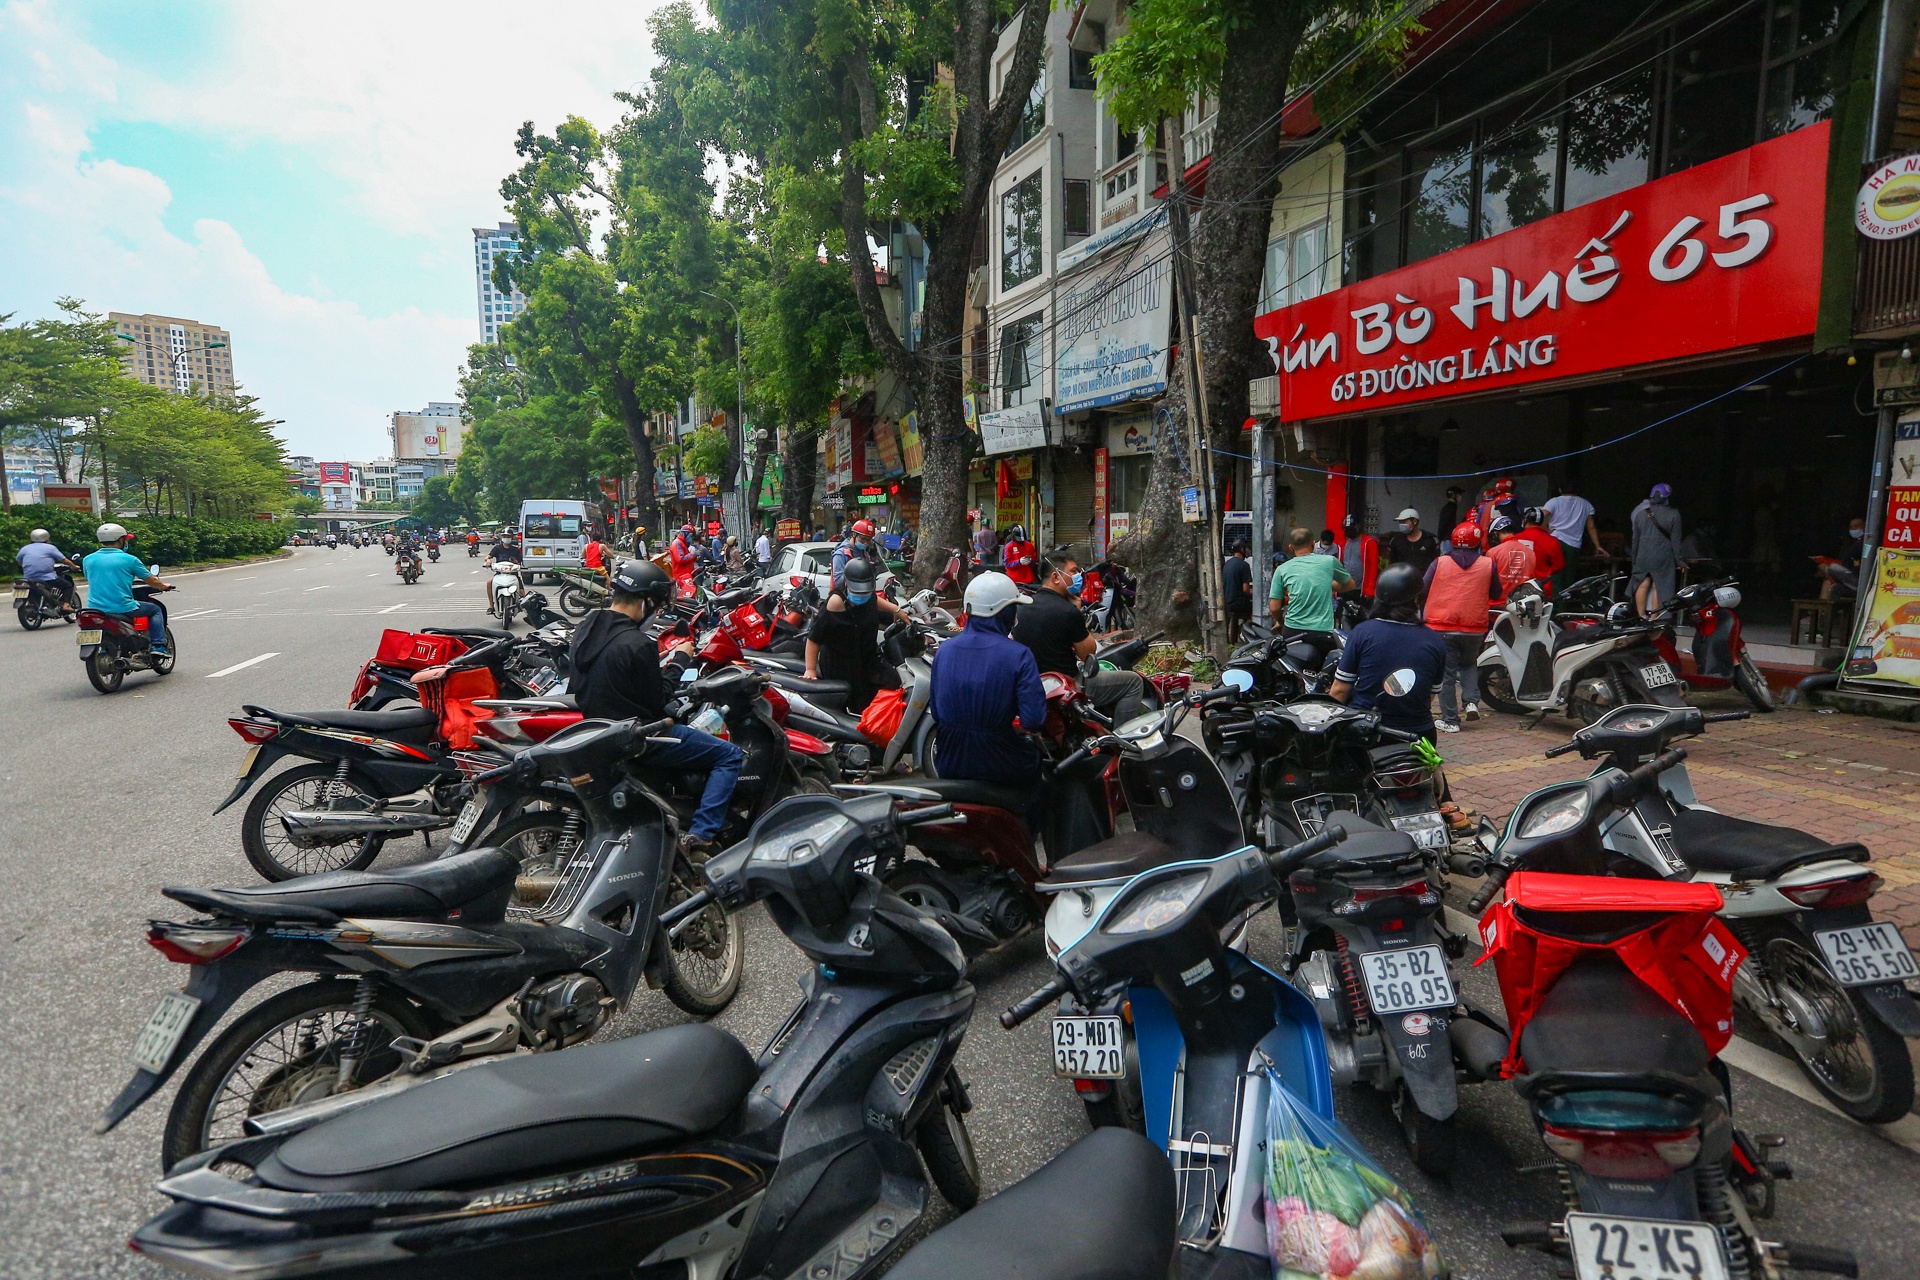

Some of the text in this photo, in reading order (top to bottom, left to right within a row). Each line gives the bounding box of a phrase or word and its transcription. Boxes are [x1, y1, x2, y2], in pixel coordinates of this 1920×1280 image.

[1868, 168, 1896, 190] HA
[1858, 207, 1869, 226] THE
[1866, 221, 1886, 235] NO.1
[1350, 292, 1434, 356] Bò
[1450, 209, 1633, 331] Huế
[1648, 193, 1774, 283] 65
[1331, 336, 1557, 402] 65 ĐƯỜNG LÁNG
[1888, 526, 1913, 542] CÀ
[1614, 831, 1638, 841] HONDA
[607, 870, 645, 884] HONDA
[1828, 926, 1894, 956] 29-H1
[1373, 950, 1435, 981] 35-B2
[1835, 951, 1915, 983] 365.50
[1373, 976, 1450, 1009] 568.95
[1057, 1049, 1120, 1074] 352.20
[533, 1162, 639, 1195] BLADE
[1608, 1182, 1656, 1193] HONDA
[1589, 1222, 1703, 1276] 22-K5
